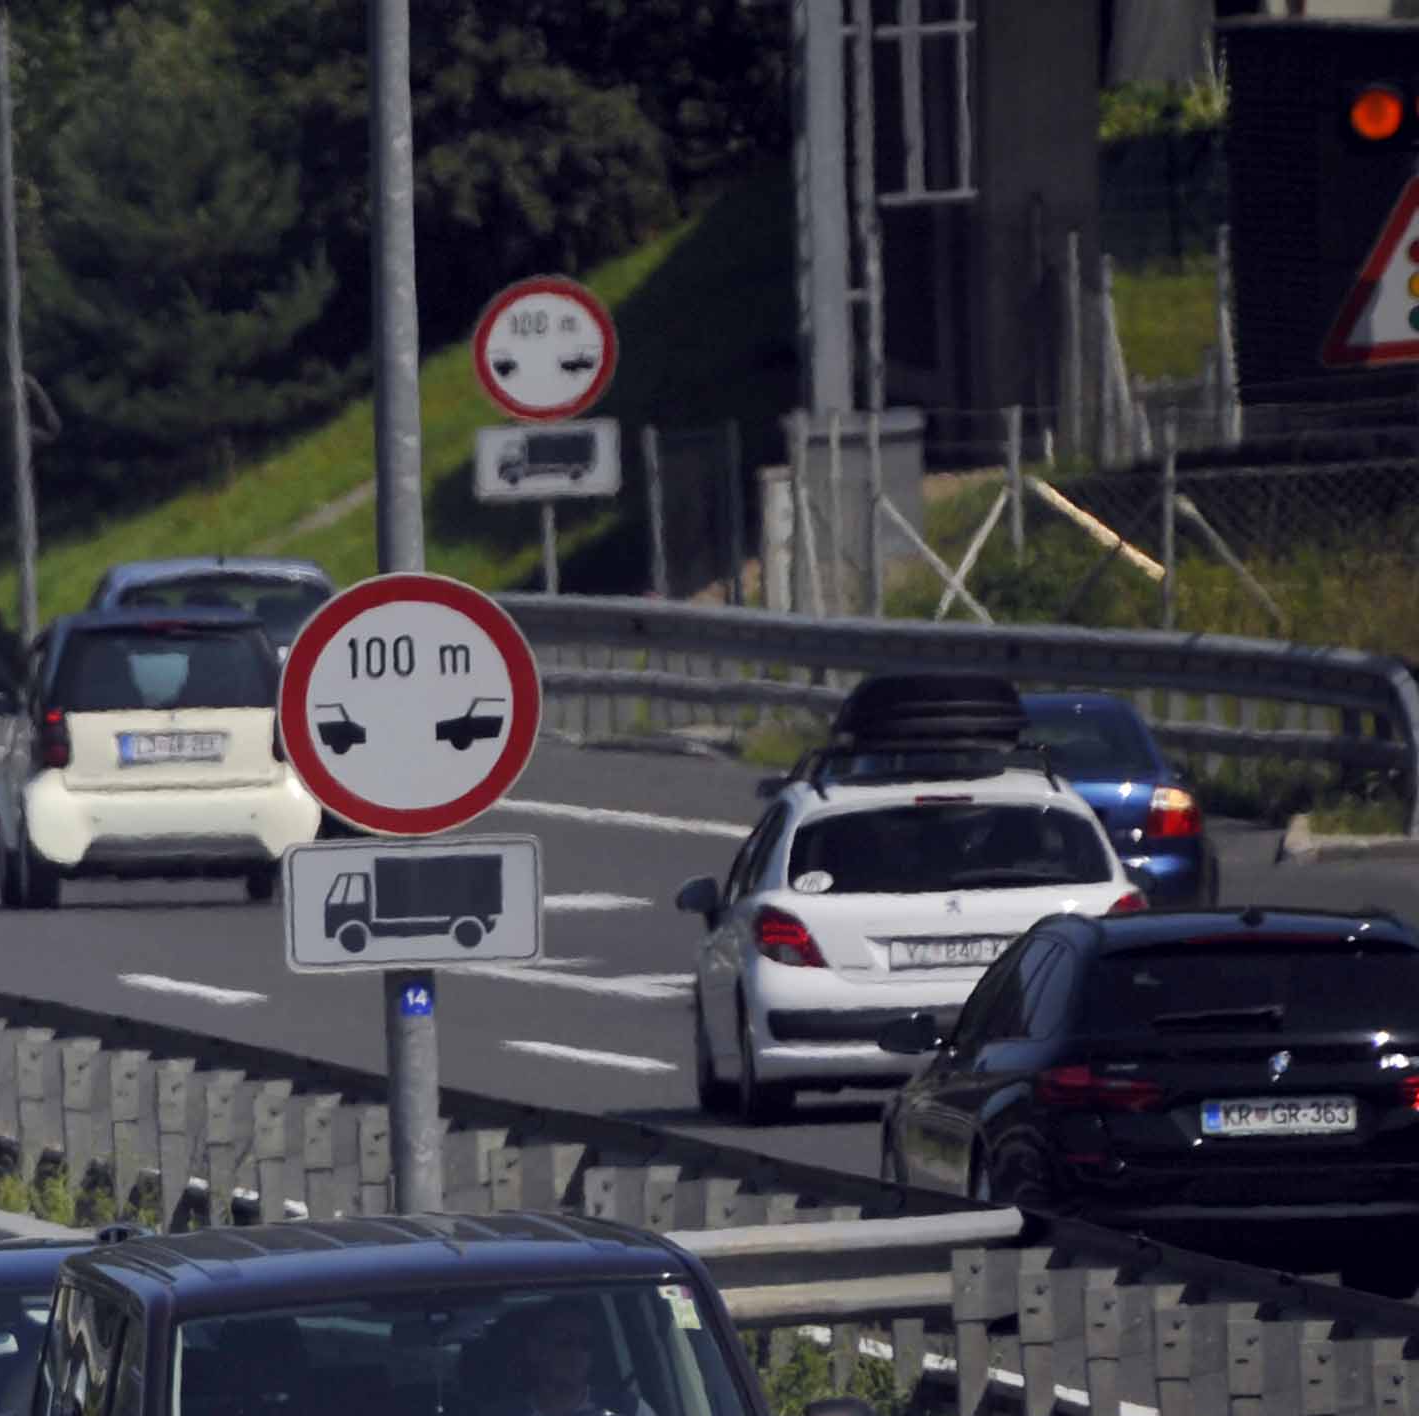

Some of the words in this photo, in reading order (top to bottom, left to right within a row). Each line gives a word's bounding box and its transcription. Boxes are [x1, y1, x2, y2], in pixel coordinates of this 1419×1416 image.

[510, 310, 548, 336] 100
[347, 635, 415, 679] 100
[439, 643, 470, 675] m
[406, 988, 428, 1007] 14
[1223, 1104, 1252, 1126] KR
[1272, 1101, 1350, 1125] GR-363
